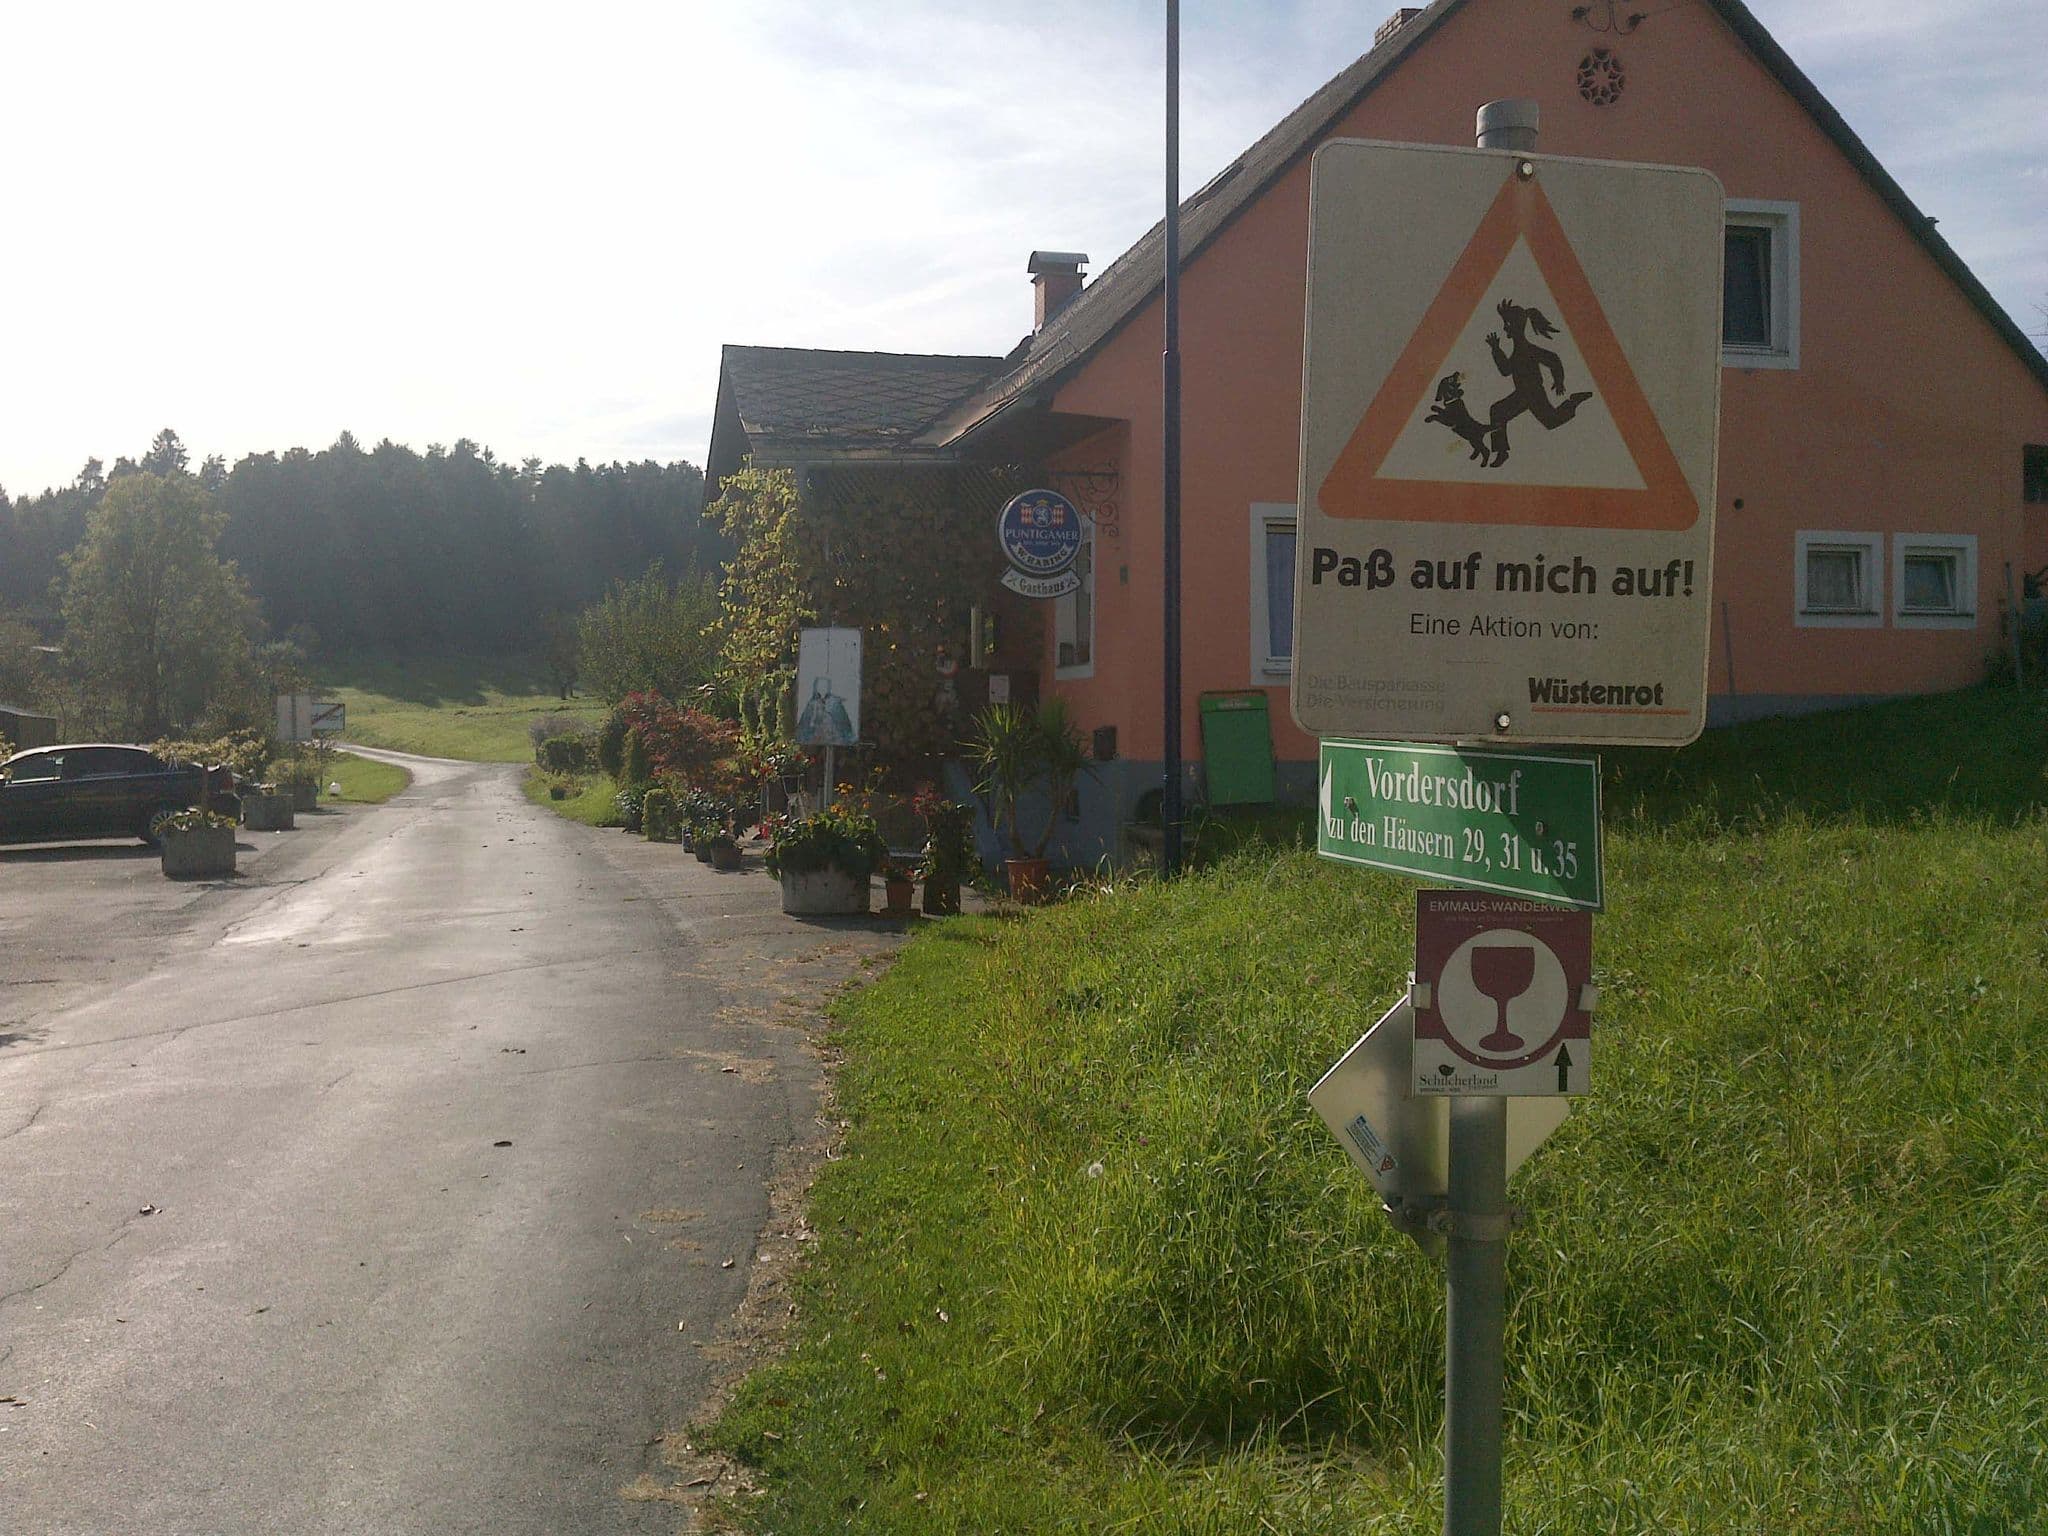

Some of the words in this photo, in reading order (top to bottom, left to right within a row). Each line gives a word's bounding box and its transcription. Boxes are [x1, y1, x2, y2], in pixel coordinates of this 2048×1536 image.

[1005, 528, 1079, 541] PUNTIGAMER
[1312, 548, 1395, 590] Paß
[1410, 552, 1482, 590] auf
[1496, 553, 1596, 594] mich
[1612, 559, 1694, 597] auf!
[1020, 579, 1065, 596] Gasthaus
[1410, 613, 1460, 636] Eine
[1469, 615, 1541, 639] Aktion
[1551, 621, 1599, 640] von:
[1529, 677, 1664, 705] Wüstenrot
[1365, 757, 1522, 816] Vordersdorf
[1329, 817, 1344, 841] zu
[1351, 814, 1376, 846] den
[1384, 815, 1454, 860] Häusern
[1463, 828, 1491, 873] 29,
[1500, 832, 1521, 871] 31
[1531, 848, 1550, 875] u.
[1553, 840, 1578, 880] 35
[1419, 1073, 1498, 1087] Schilcherland
